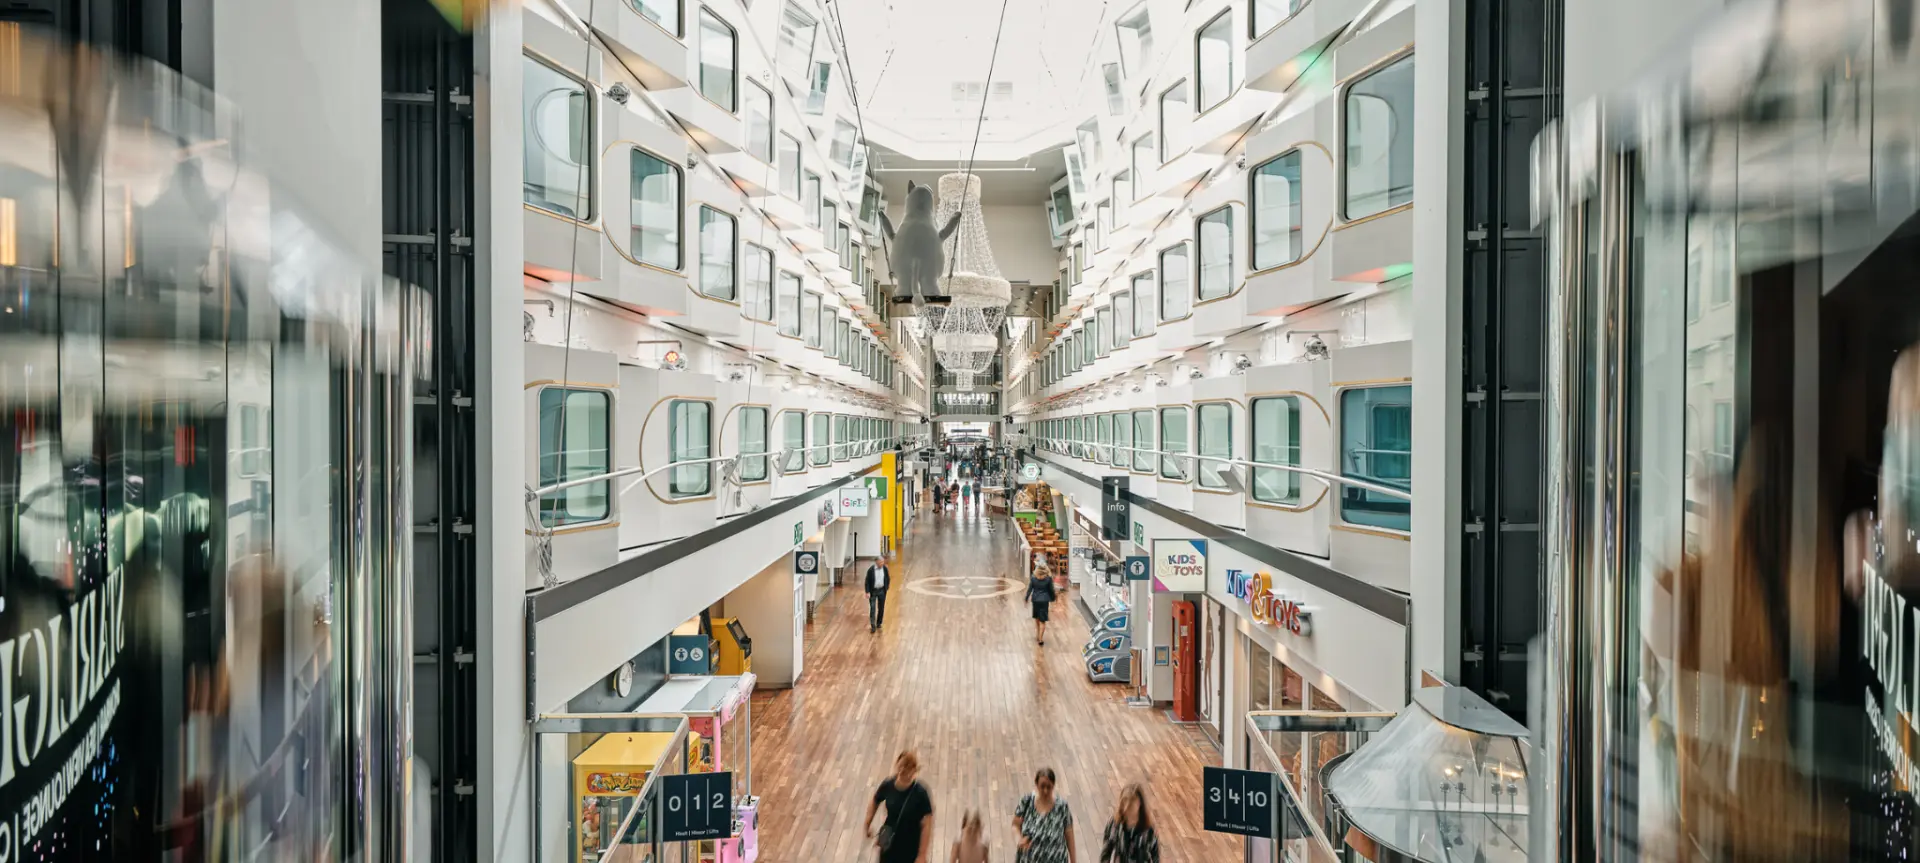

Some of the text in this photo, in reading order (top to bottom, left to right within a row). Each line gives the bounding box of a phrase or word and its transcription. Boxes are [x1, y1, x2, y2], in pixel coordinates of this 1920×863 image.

[1107, 503, 1125, 511] info
[1168, 555, 1196, 565] KIDS
[1174, 565, 1202, 576] TOYS
[1226, 569, 1253, 604] KIDS
[1264, 595, 1302, 637] TOYS
[669, 793, 724, 812] 0 1 2
[1210, 787, 1267, 807] 3 4 10
